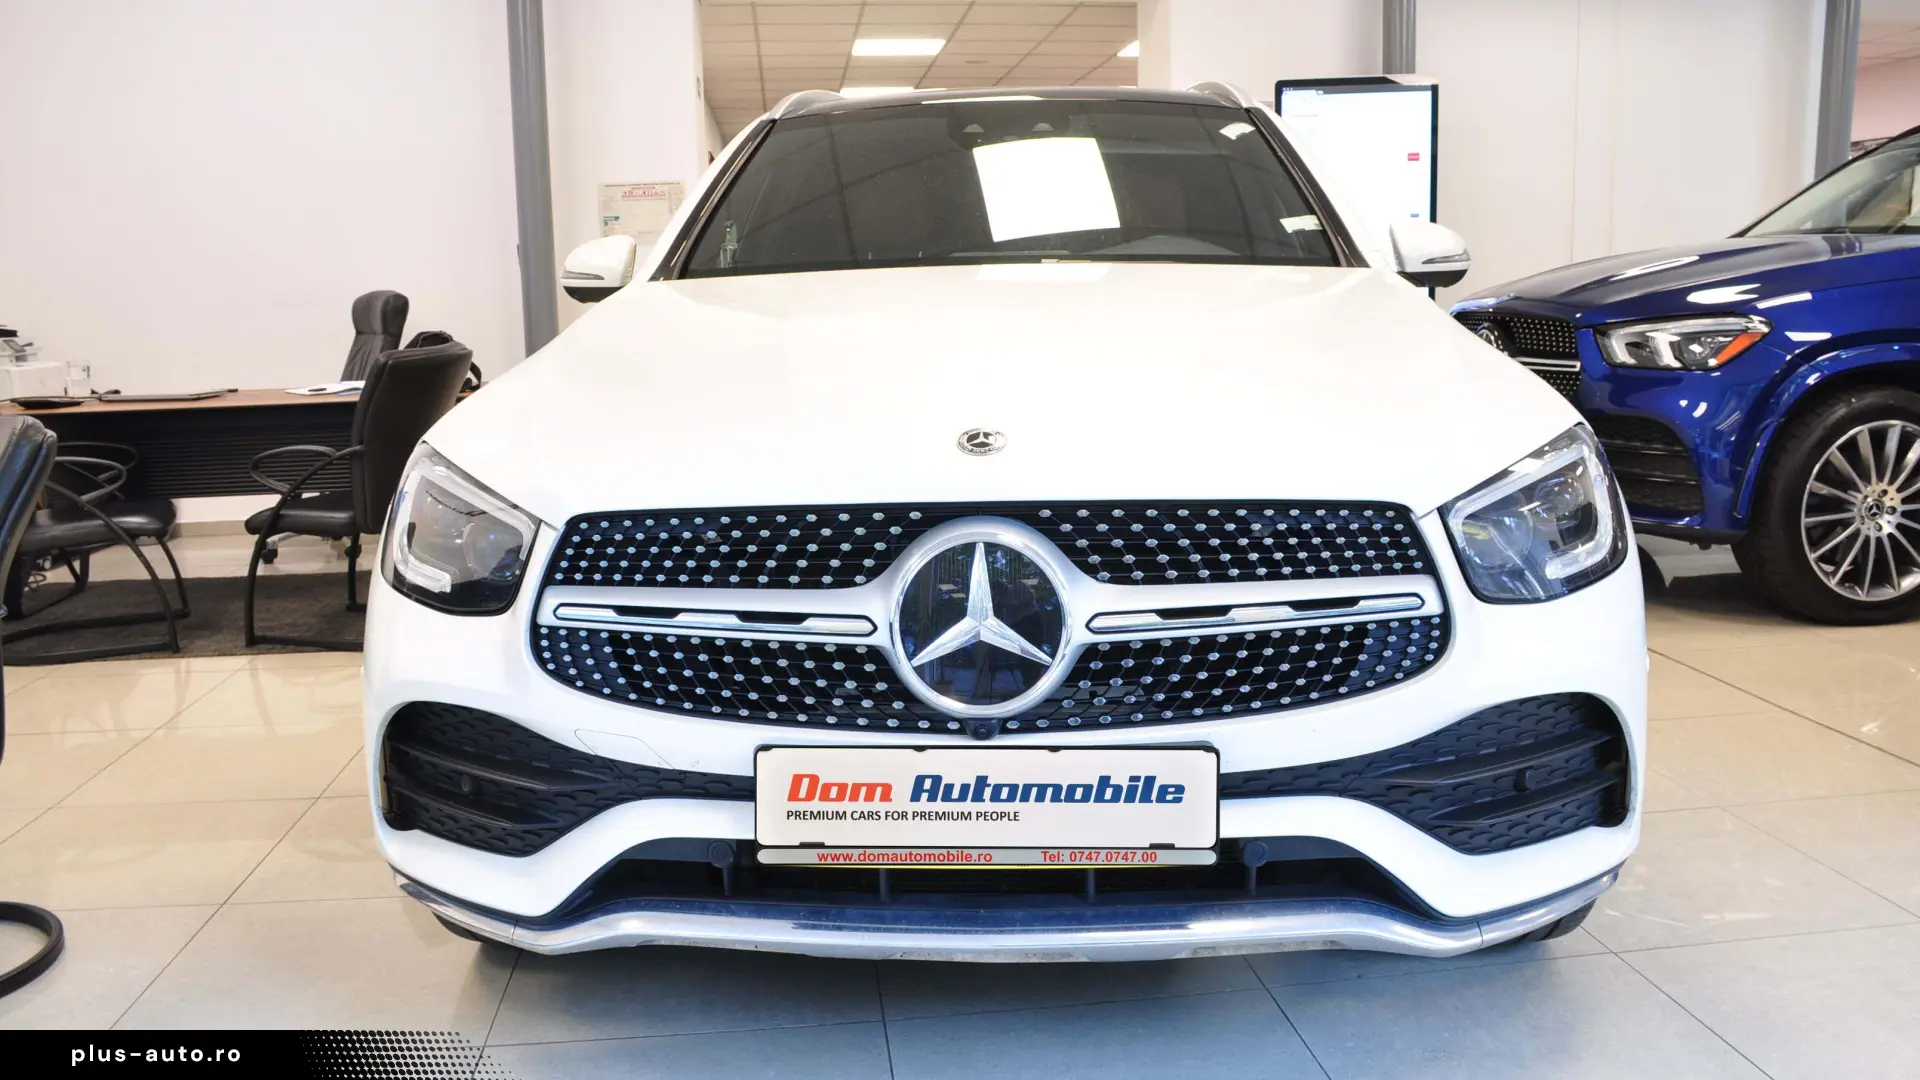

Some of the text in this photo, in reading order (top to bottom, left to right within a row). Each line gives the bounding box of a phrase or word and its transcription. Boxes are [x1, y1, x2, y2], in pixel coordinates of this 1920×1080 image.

[787, 773, 1186, 804] Dom Automobile
[786, 810, 1020, 822] PREMIUM CARS FOR PREMIUM PEOPLE
[816, 850, 1158, 863] www.domautomobile.ro Tel: 0747.0747.00
